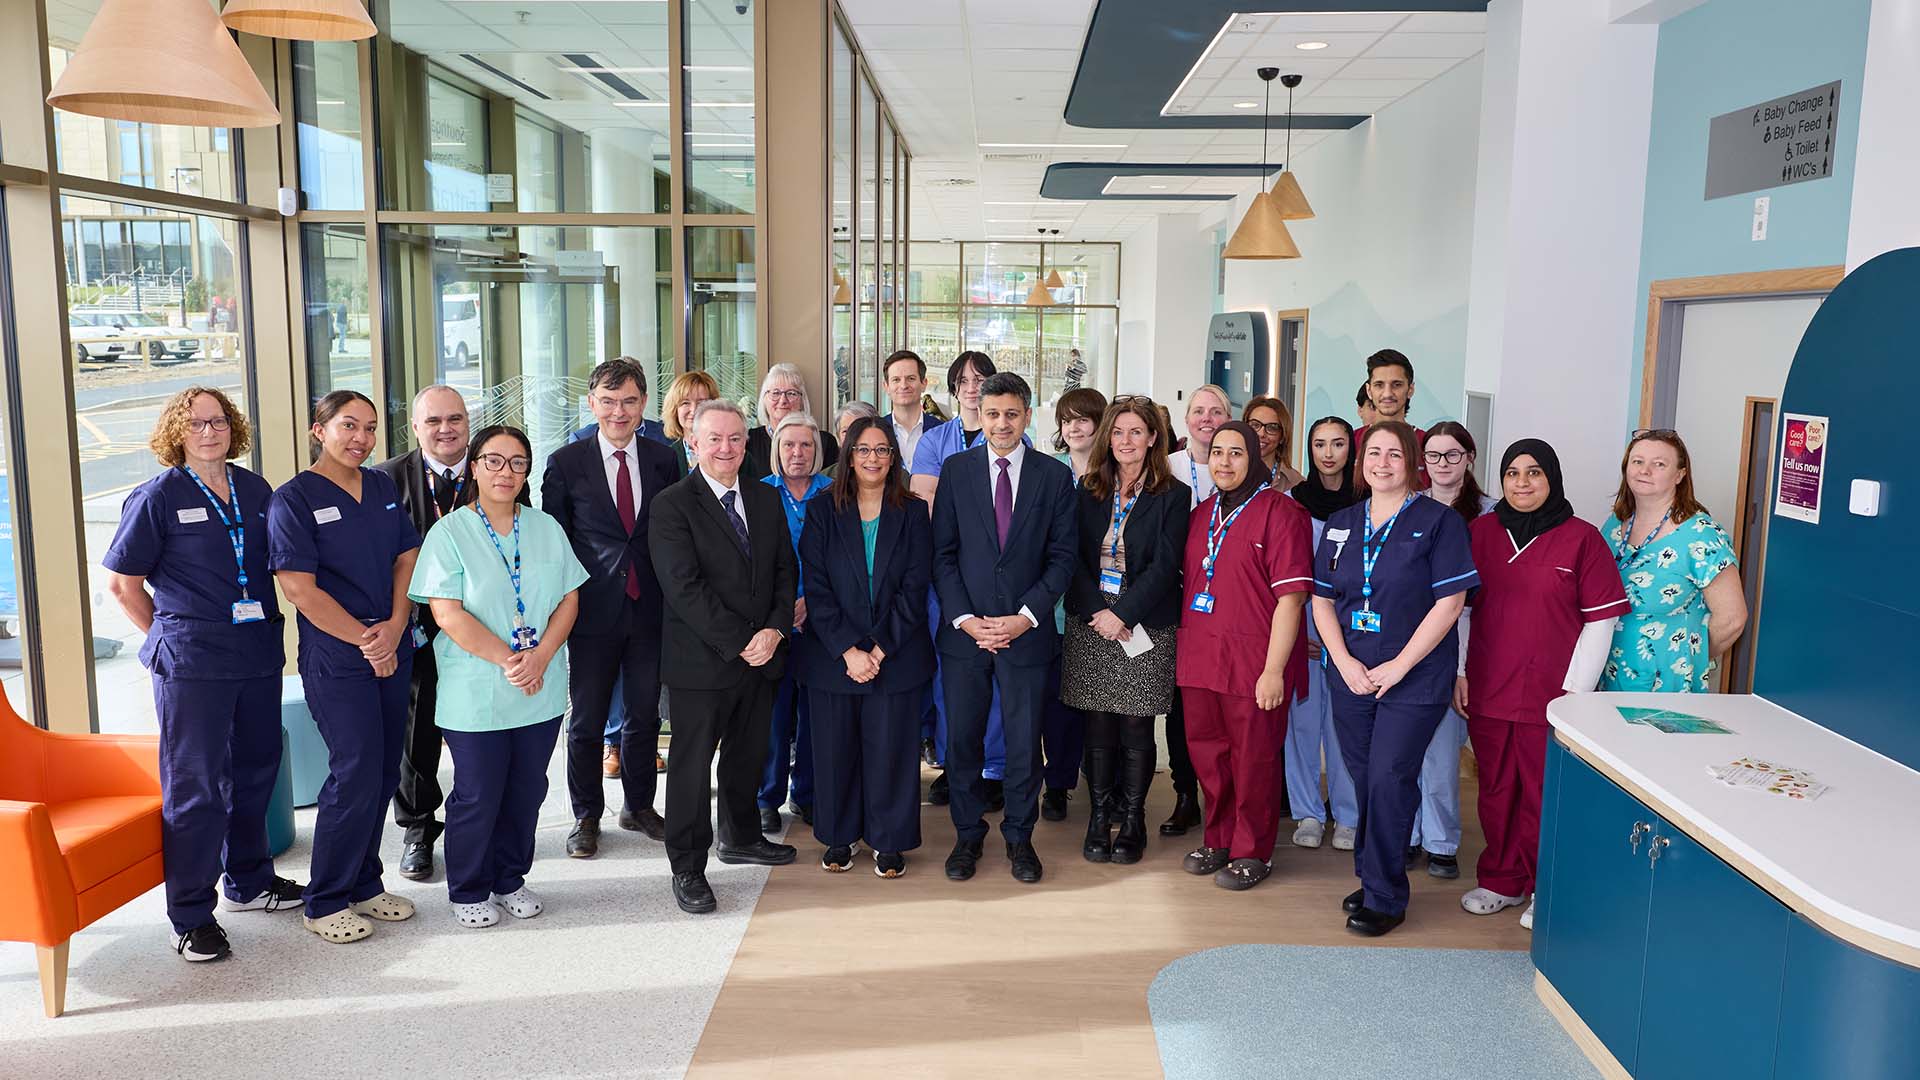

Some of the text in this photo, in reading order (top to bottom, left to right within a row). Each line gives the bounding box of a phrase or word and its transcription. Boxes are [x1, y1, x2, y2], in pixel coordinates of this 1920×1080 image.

[1764, 95, 1824, 122] Baby Change
[1774, 115, 1822, 140] Baby Feed
[1796, 140, 1819, 156] Toilet
[1793, 162, 1816, 178] WC's
[1790, 430, 1804, 440] Good
[1808, 425, 1821, 434] Poor
[1784, 457, 1819, 473] Tell us now
